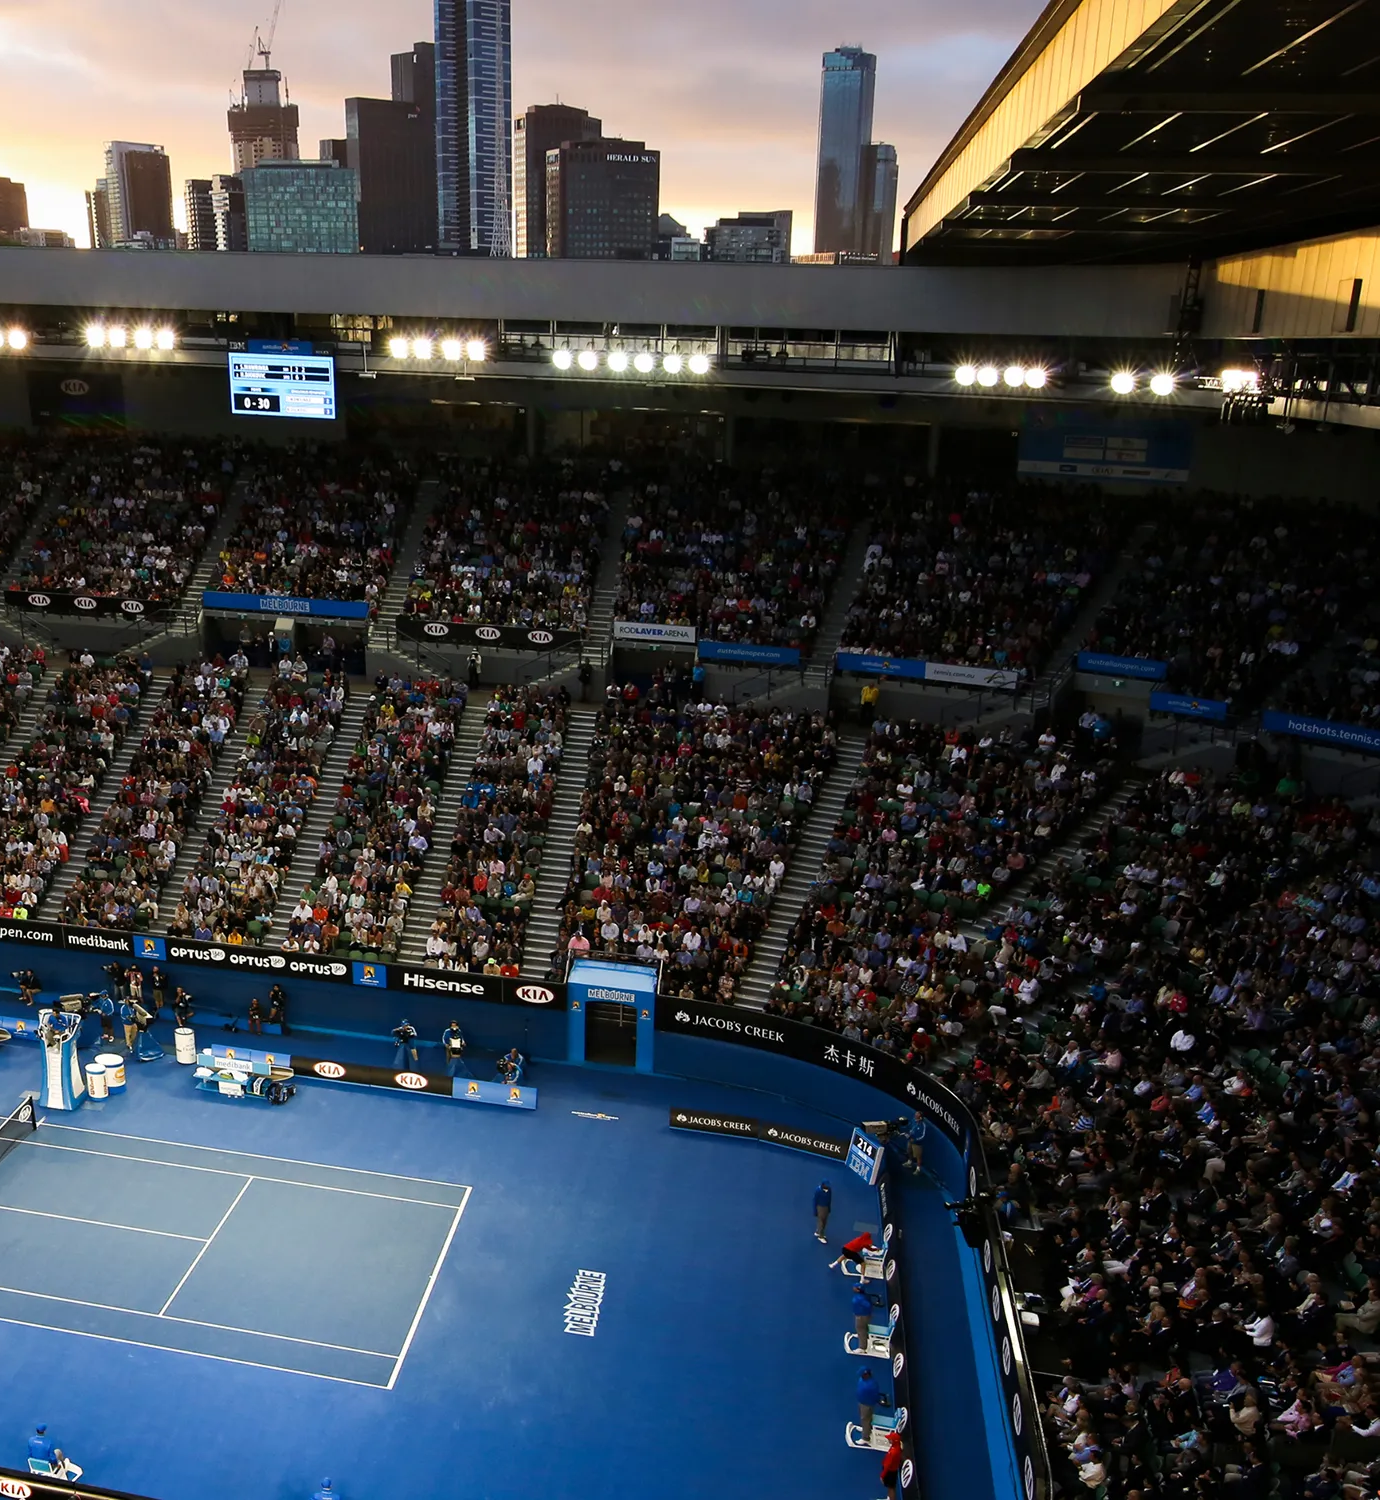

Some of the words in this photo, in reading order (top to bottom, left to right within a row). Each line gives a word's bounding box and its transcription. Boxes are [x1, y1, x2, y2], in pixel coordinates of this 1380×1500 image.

[606, 154, 639, 162] HERALD
[640, 155, 657, 163] SUN
[229, 341, 246, 350] IBM
[64, 383, 86, 392] KIA
[30, 596, 49, 604] KIA
[76, 599, 95, 608] KIA
[123, 603, 142, 611] KIA
[260, 598, 310, 612] MELBOURNE
[426, 625, 447, 634] KIA
[478, 629, 499, 638] KIA
[530, 632, 551, 641] KIA
[68, 934, 130, 951] medibank
[170, 947, 211, 961] OPTUS
[229, 954, 270, 968] OPTUS
[290, 961, 331, 975] OPTUS
[403, 972, 485, 995] Hisense
[521, 988, 549, 1001] KIA
[587, 988, 635, 1003] MELBOURNE
[692, 1015, 742, 1033] JACOB'S
[744, 1024, 784, 1043] CREEK
[216, 1060, 251, 1070] medibank
[823, 1043, 875, 1078] 杰卡斯
[318, 1064, 341, 1076] KIA
[400, 1075, 423, 1087] KIA
[916, 1089, 944, 1117] JACOB'S
[943, 1110, 960, 1137] CREEK
[687, 1116, 723, 1128] JACOB'S
[723, 1120, 751, 1131] CREEK
[778, 1131, 812, 1146] JACOB'S
[813, 1139, 841, 1153] CREEK
[856, 1137, 873, 1157] 214
[848, 1153, 870, 1183] IBM
[564, 1270, 606, 1336] MELBOURNE
[0, 1481, 26, 1497] KIA
